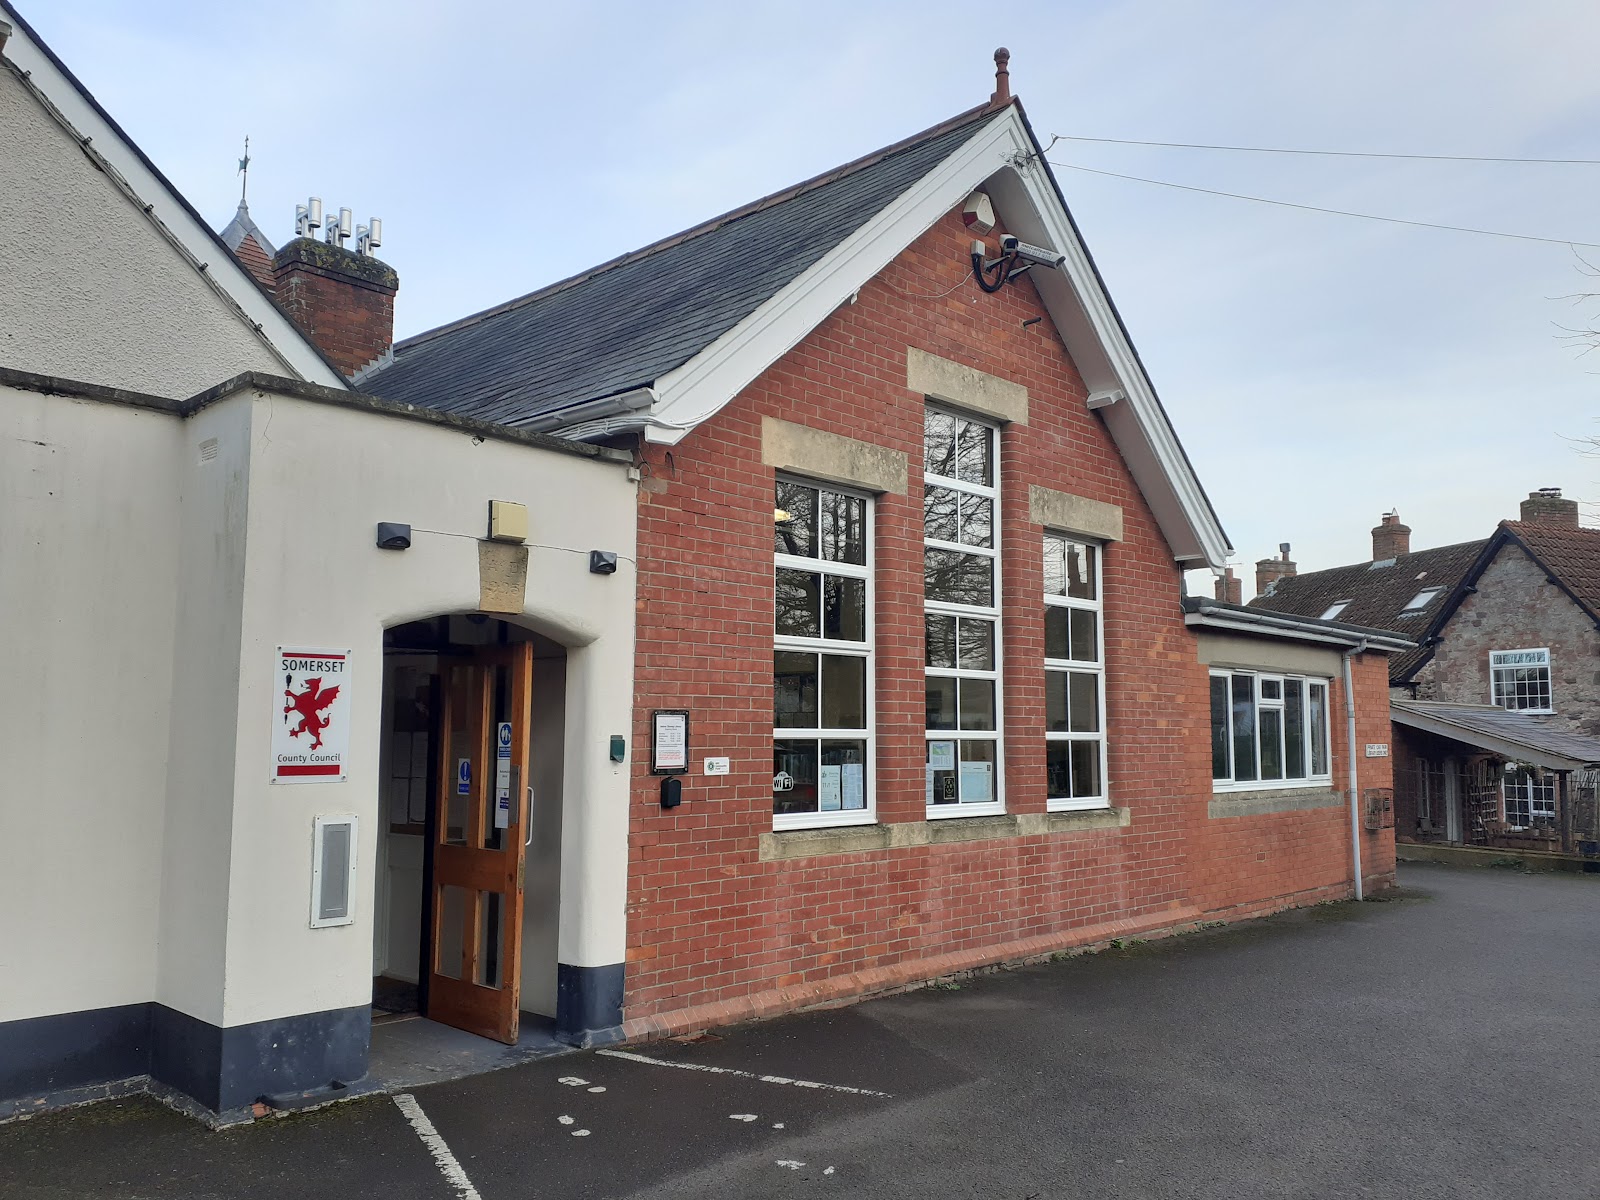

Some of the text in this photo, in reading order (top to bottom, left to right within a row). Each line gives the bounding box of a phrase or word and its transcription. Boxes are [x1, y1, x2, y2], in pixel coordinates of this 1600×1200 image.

[282, 659, 345, 672] SOMERSET
[278, 753, 341, 764] County Council
